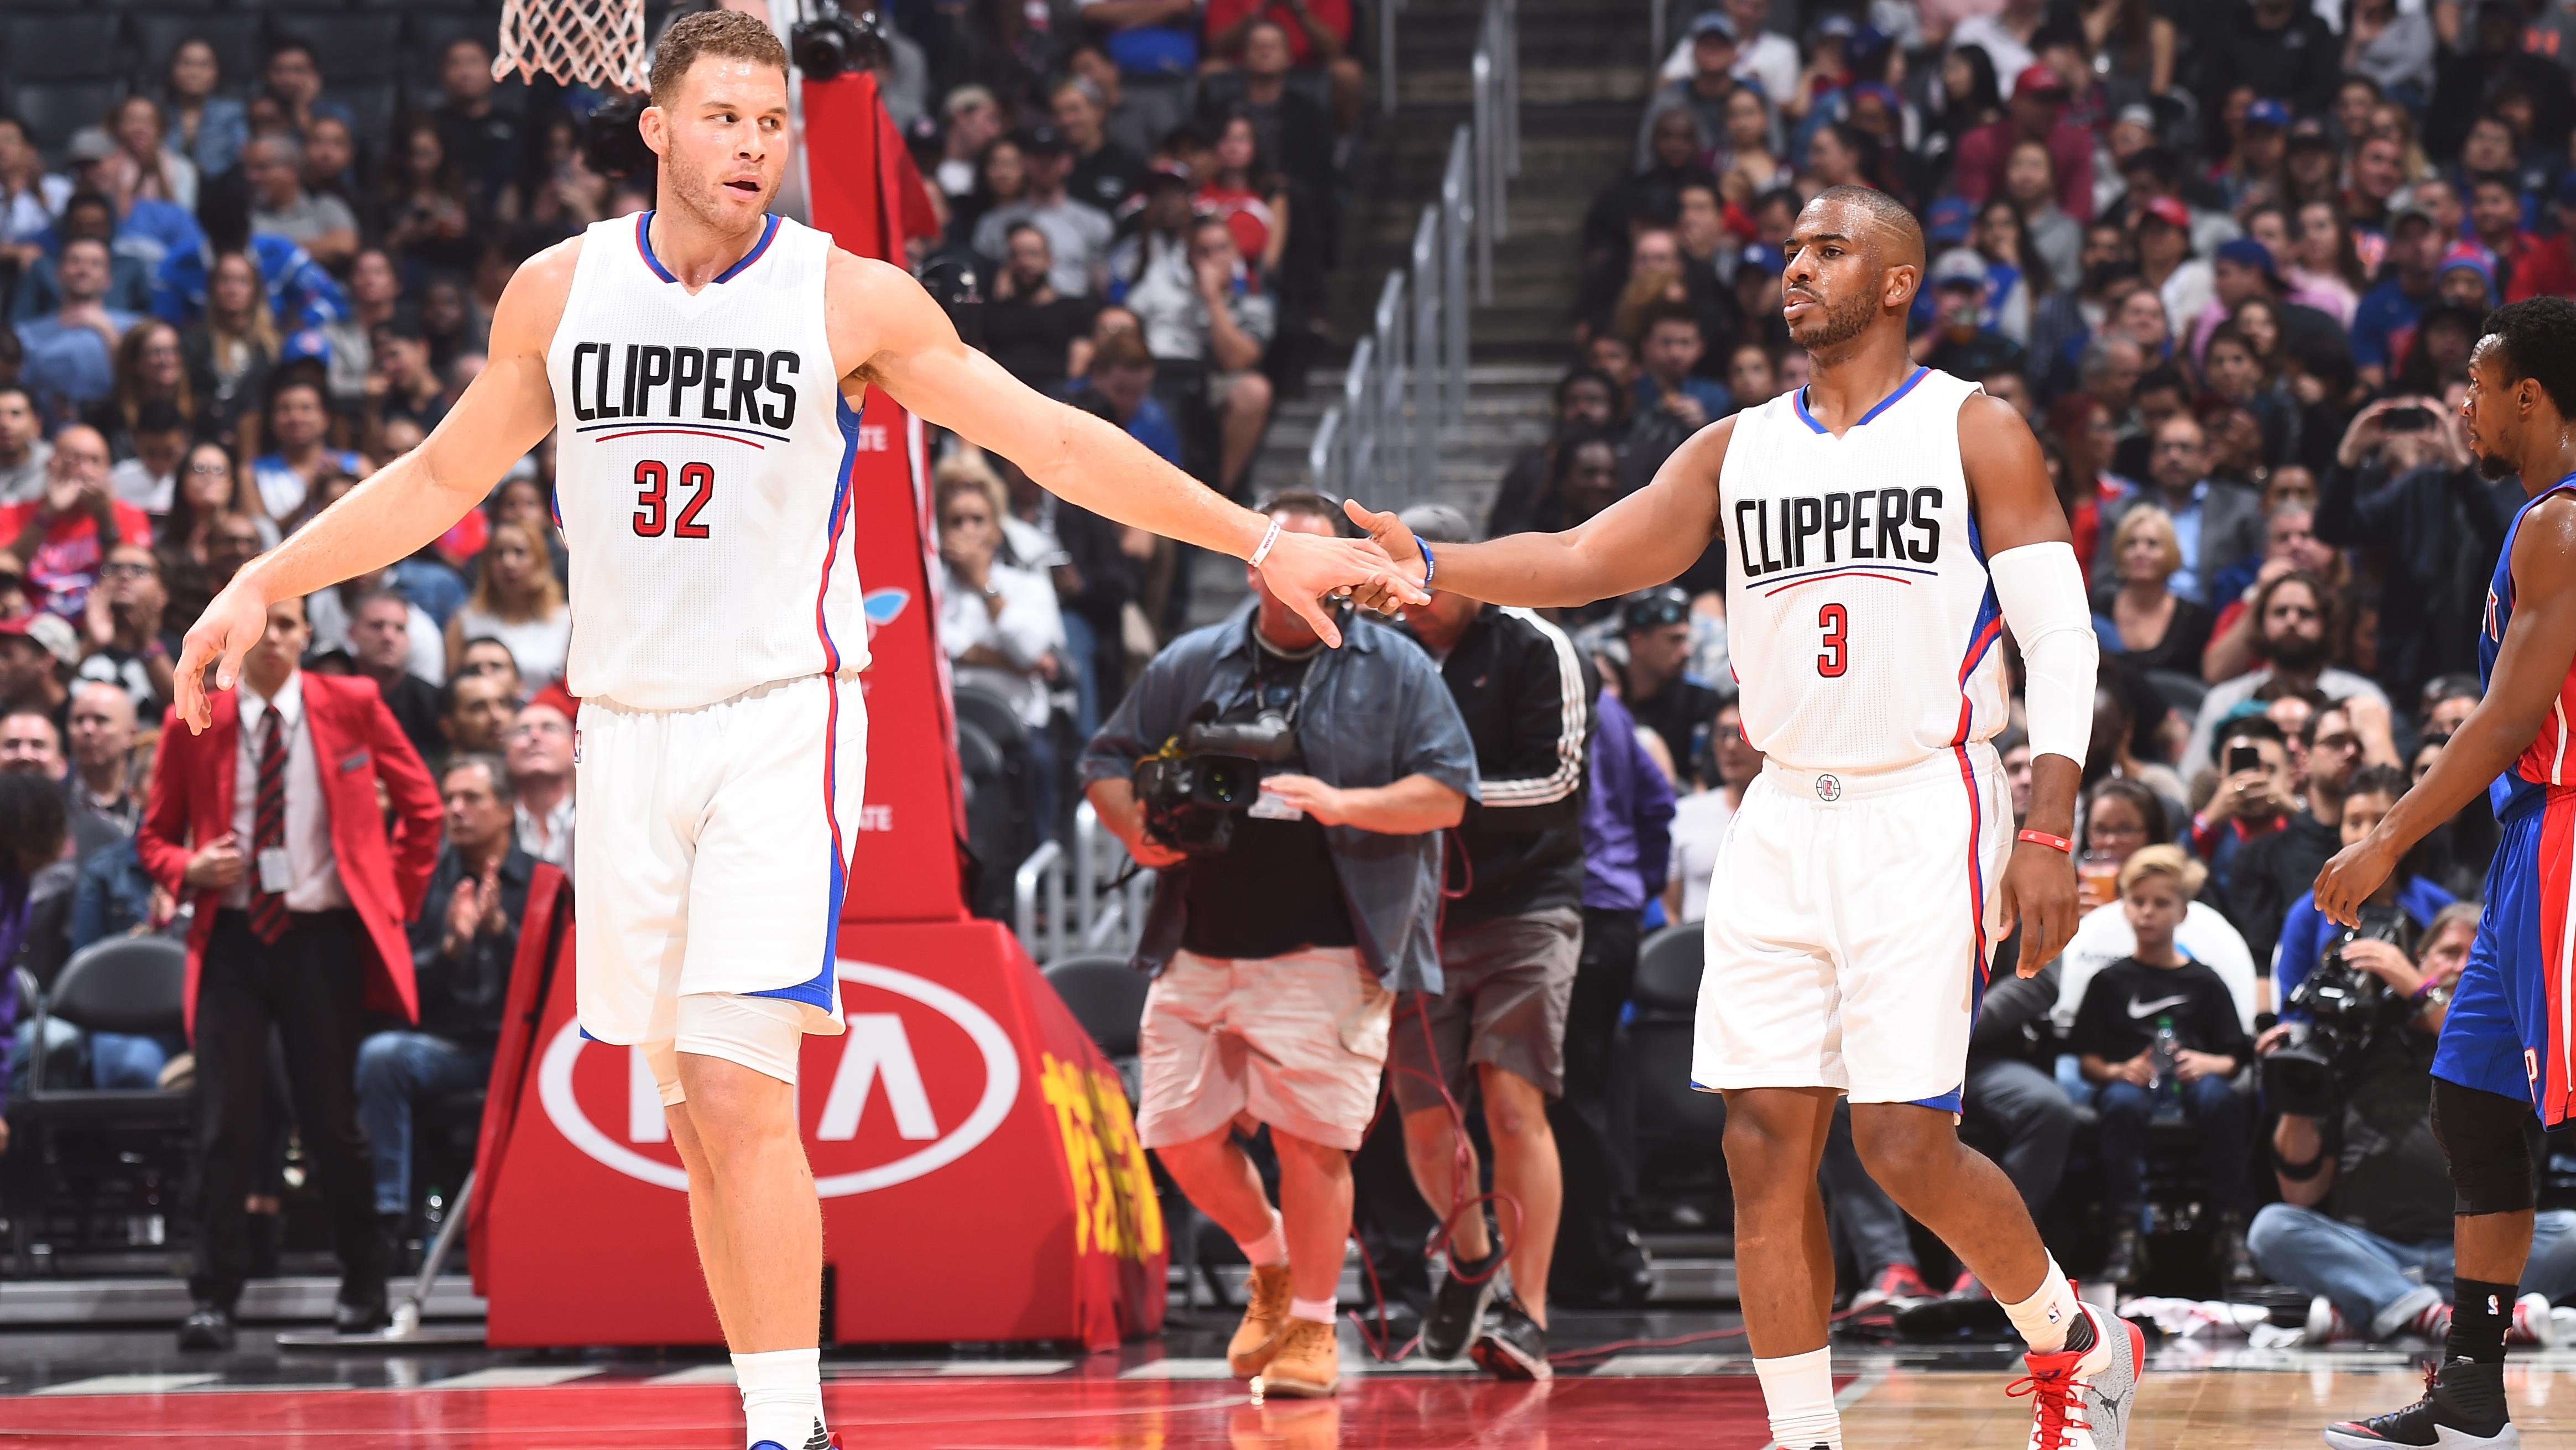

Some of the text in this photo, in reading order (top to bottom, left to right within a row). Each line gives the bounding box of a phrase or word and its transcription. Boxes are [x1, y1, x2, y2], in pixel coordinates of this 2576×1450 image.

[572, 341, 800, 430] CLIPPERS
[633, 460, 715, 539] 32
[1734, 486, 1943, 577] CLIPPERS
[1817, 603, 1848, 677] 3
